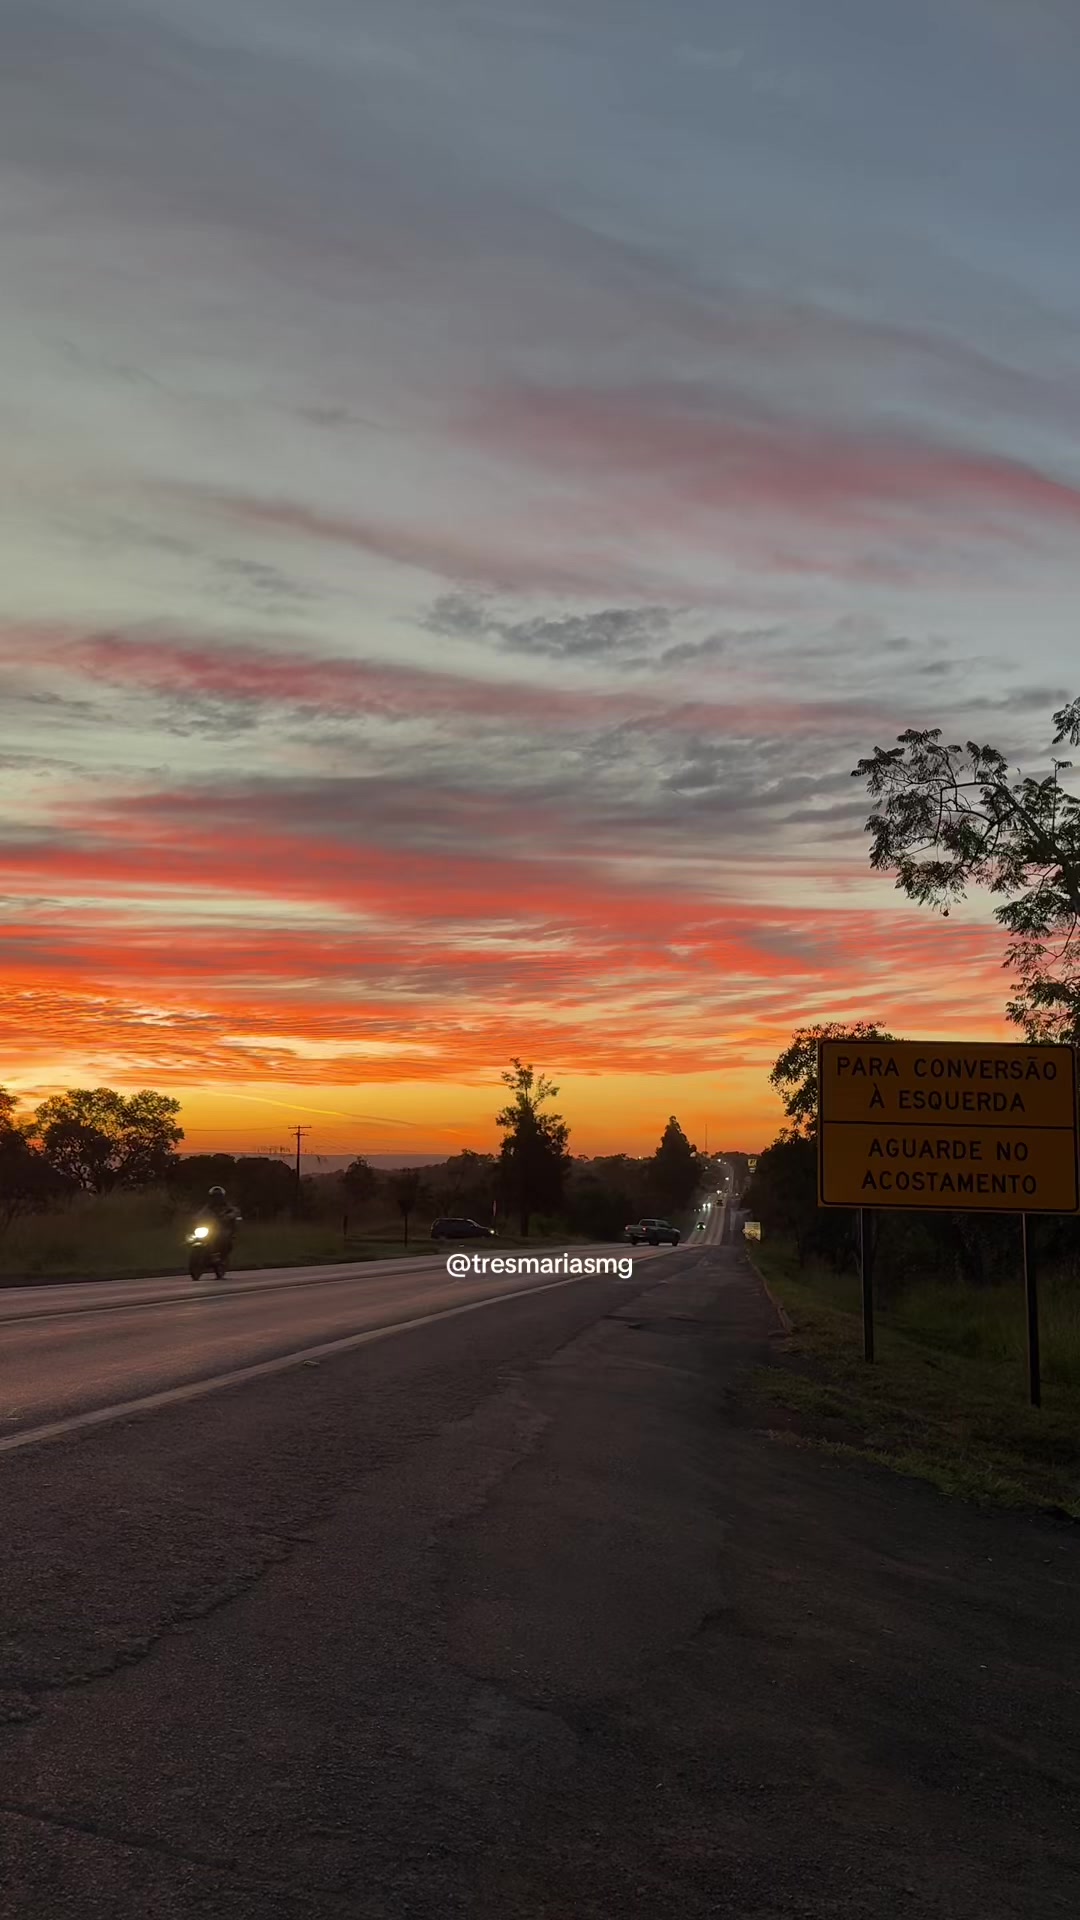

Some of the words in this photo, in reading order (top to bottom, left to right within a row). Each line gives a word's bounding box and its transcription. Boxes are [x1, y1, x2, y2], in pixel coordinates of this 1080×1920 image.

[837, 1057, 899, 1077] PARA
[913, 1056, 1057, 1081] CONVERSÃO
[869, 1083, 885, 1109] À
[898, 1090, 1026, 1112] ESQUERDA
[868, 1139, 982, 1160] AGUARDE
[996, 1141, 1028, 1161] NO
[861, 1170, 1037, 1195] ACOSTAMENTO
